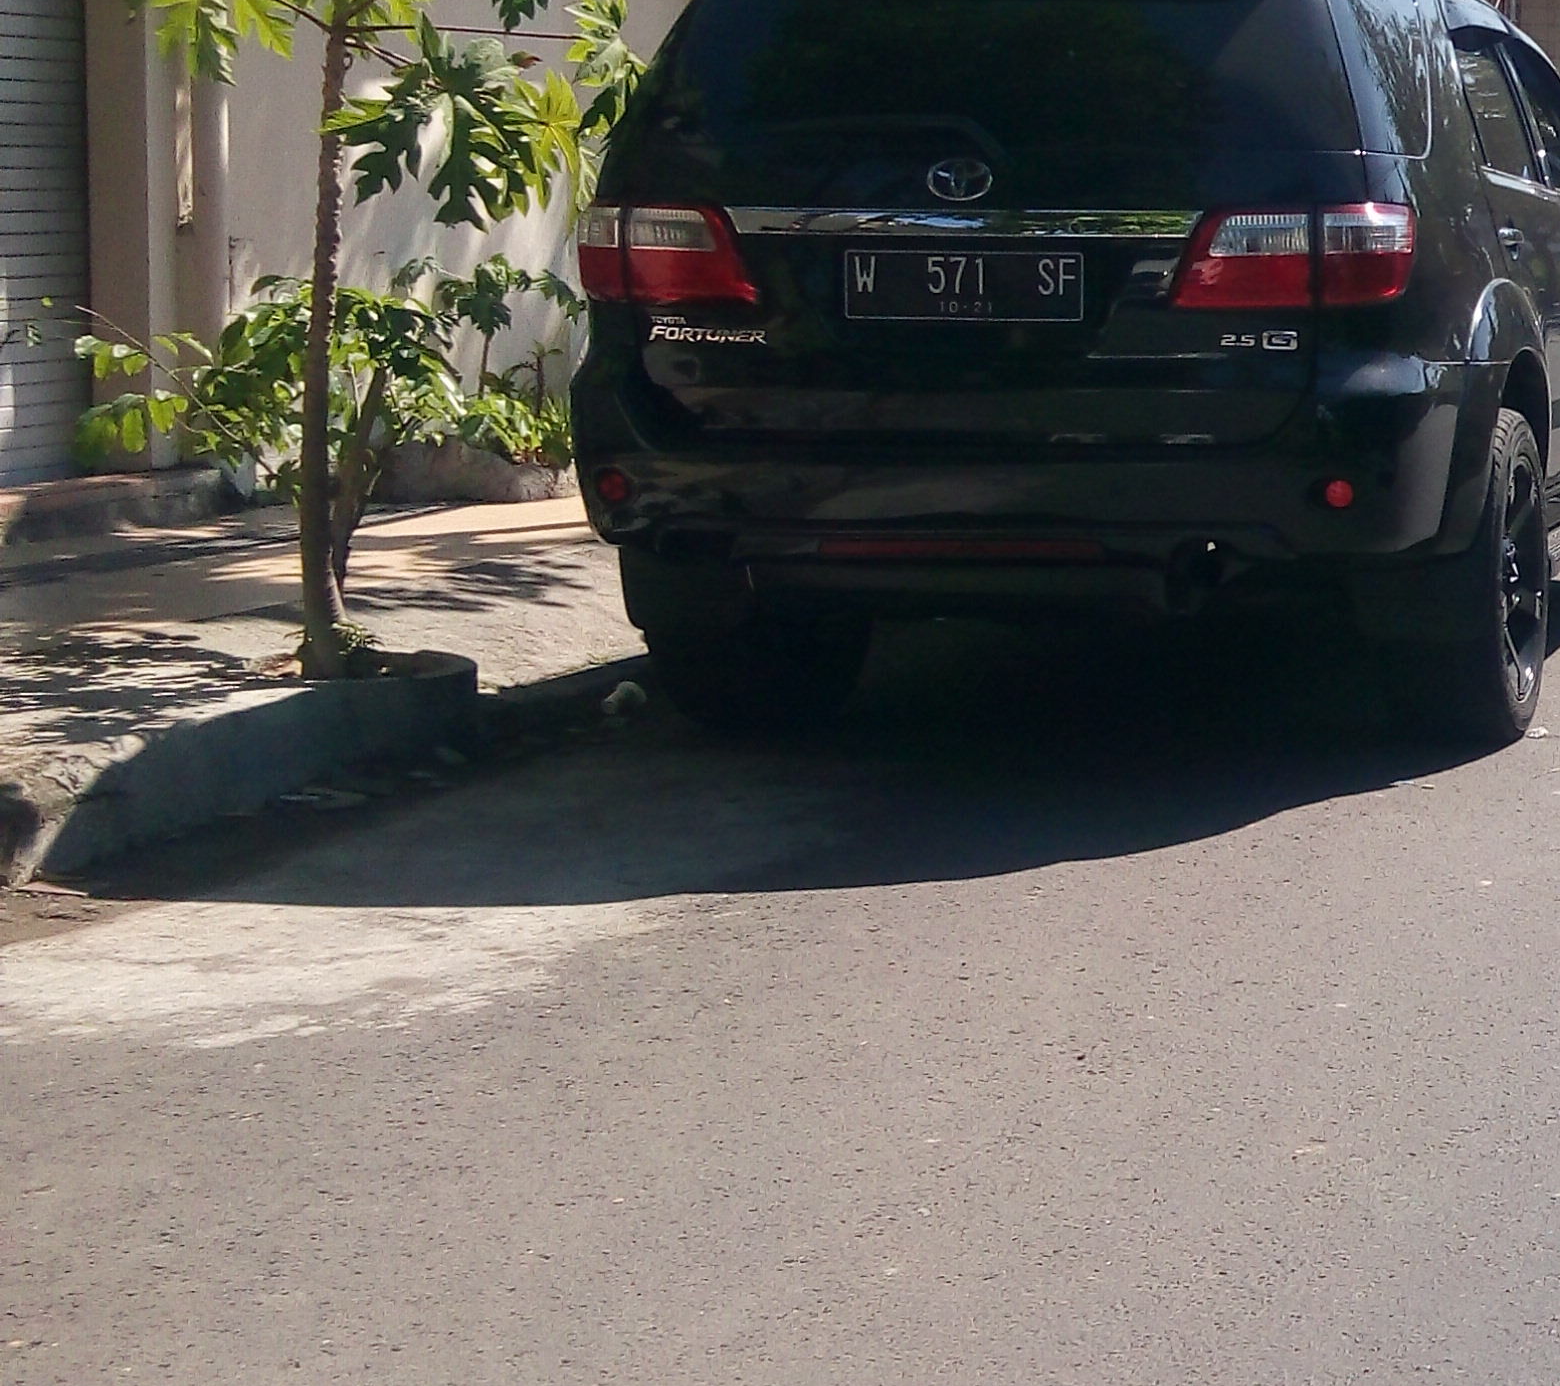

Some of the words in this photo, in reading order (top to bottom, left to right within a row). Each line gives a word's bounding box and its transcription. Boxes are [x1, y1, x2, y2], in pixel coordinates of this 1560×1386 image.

[854, 255, 876, 294] W
[927, 256, 986, 295] 571
[1037, 258, 1077, 296] SF
[650, 315, 687, 325] TOYOTA
[648, 325, 767, 344] FORTUNER
[1220, 334, 1256, 346] 2.5
